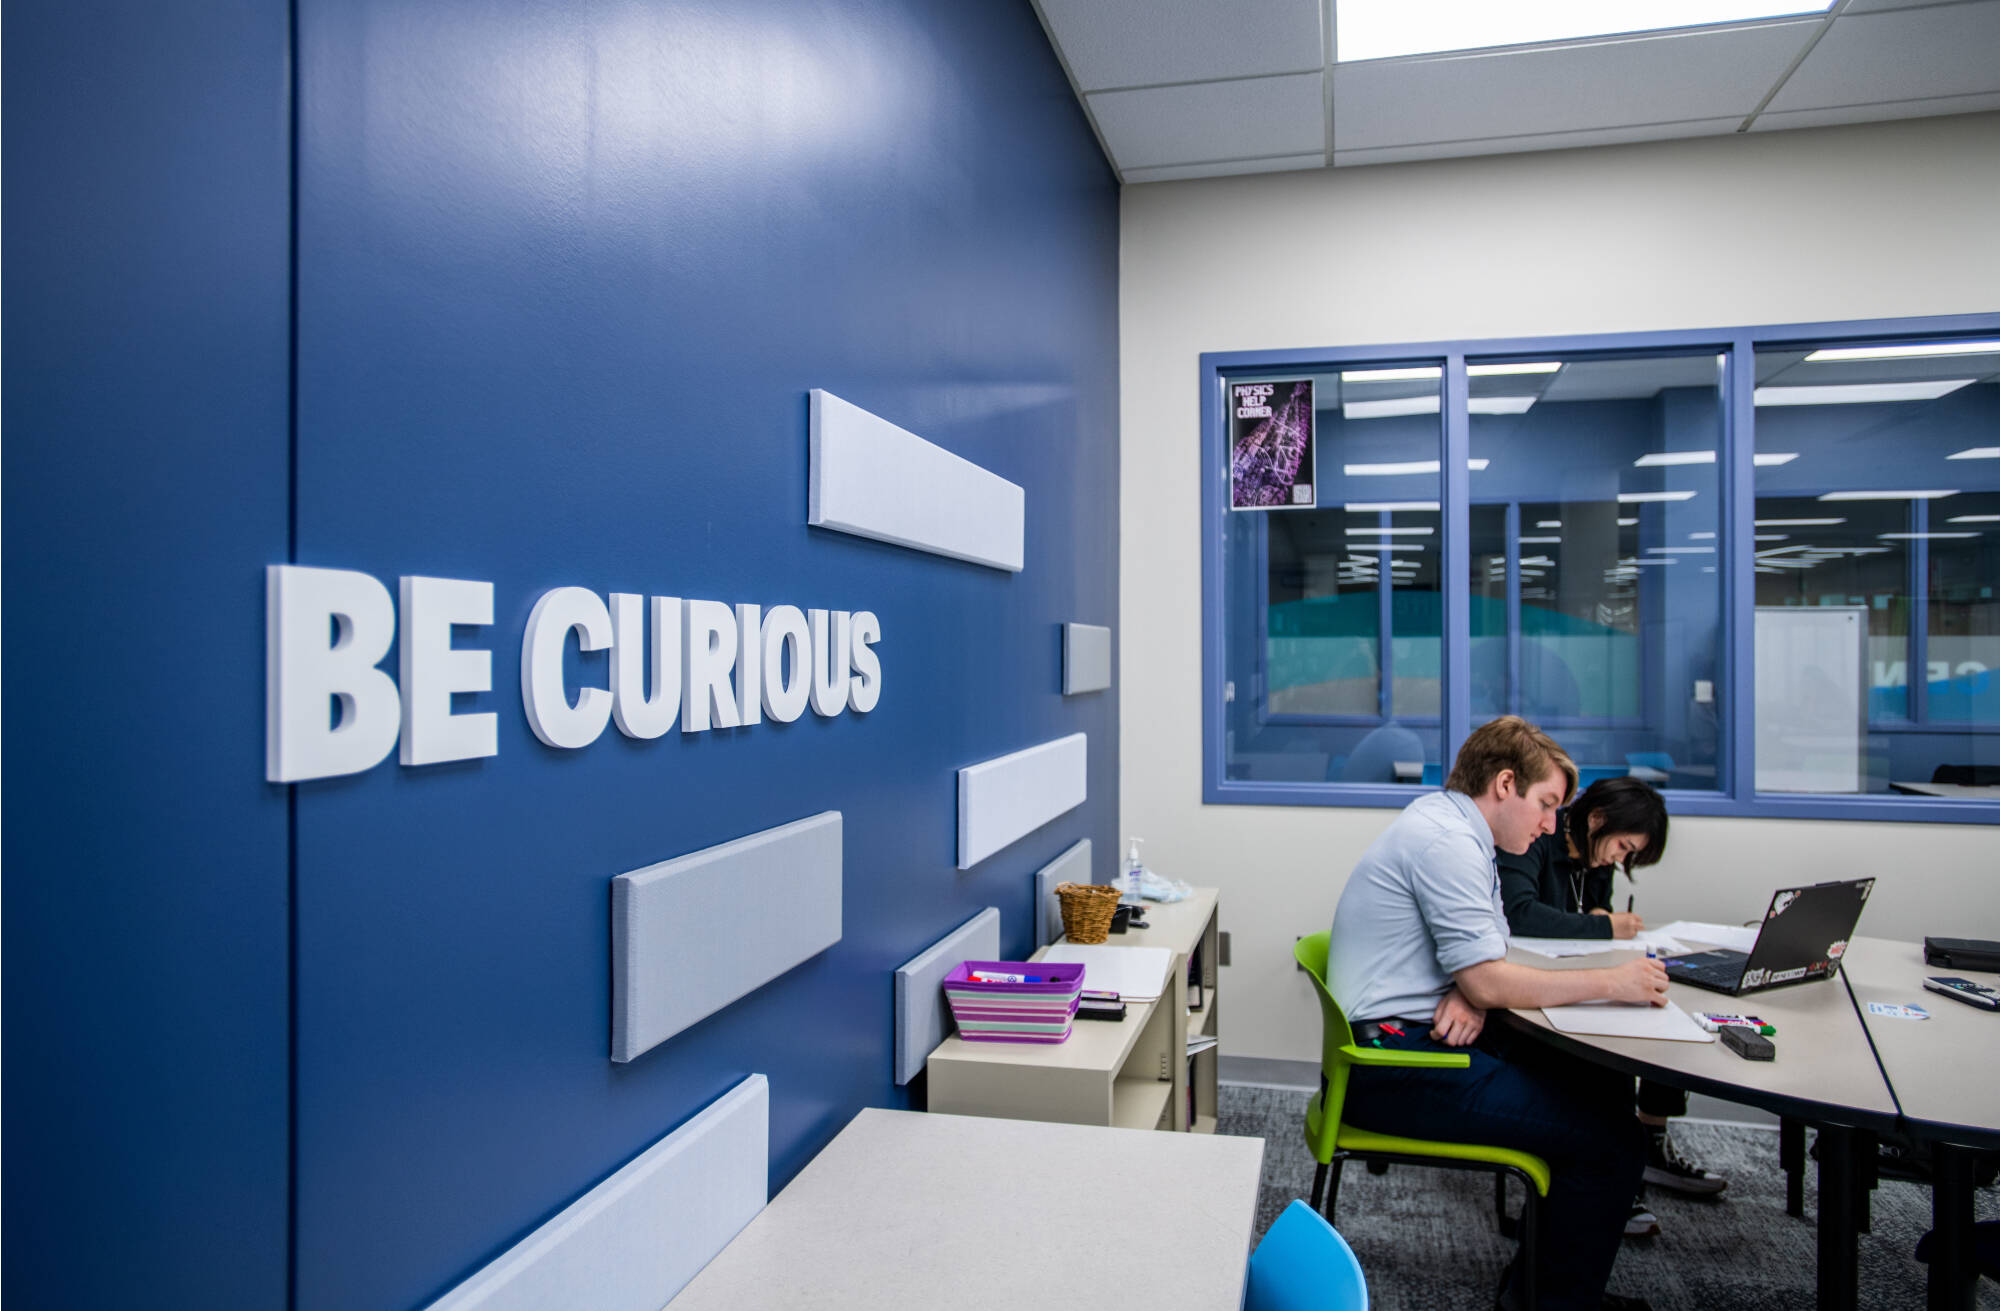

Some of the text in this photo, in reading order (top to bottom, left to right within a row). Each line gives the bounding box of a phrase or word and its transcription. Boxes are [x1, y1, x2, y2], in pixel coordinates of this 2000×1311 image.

[1235, 384, 1274, 397] PHYSICS
[1242, 395, 1267, 407] HELP
[1237, 406, 1272, 419] CORNER
[266, 564, 882, 784] BE CURIOUS
